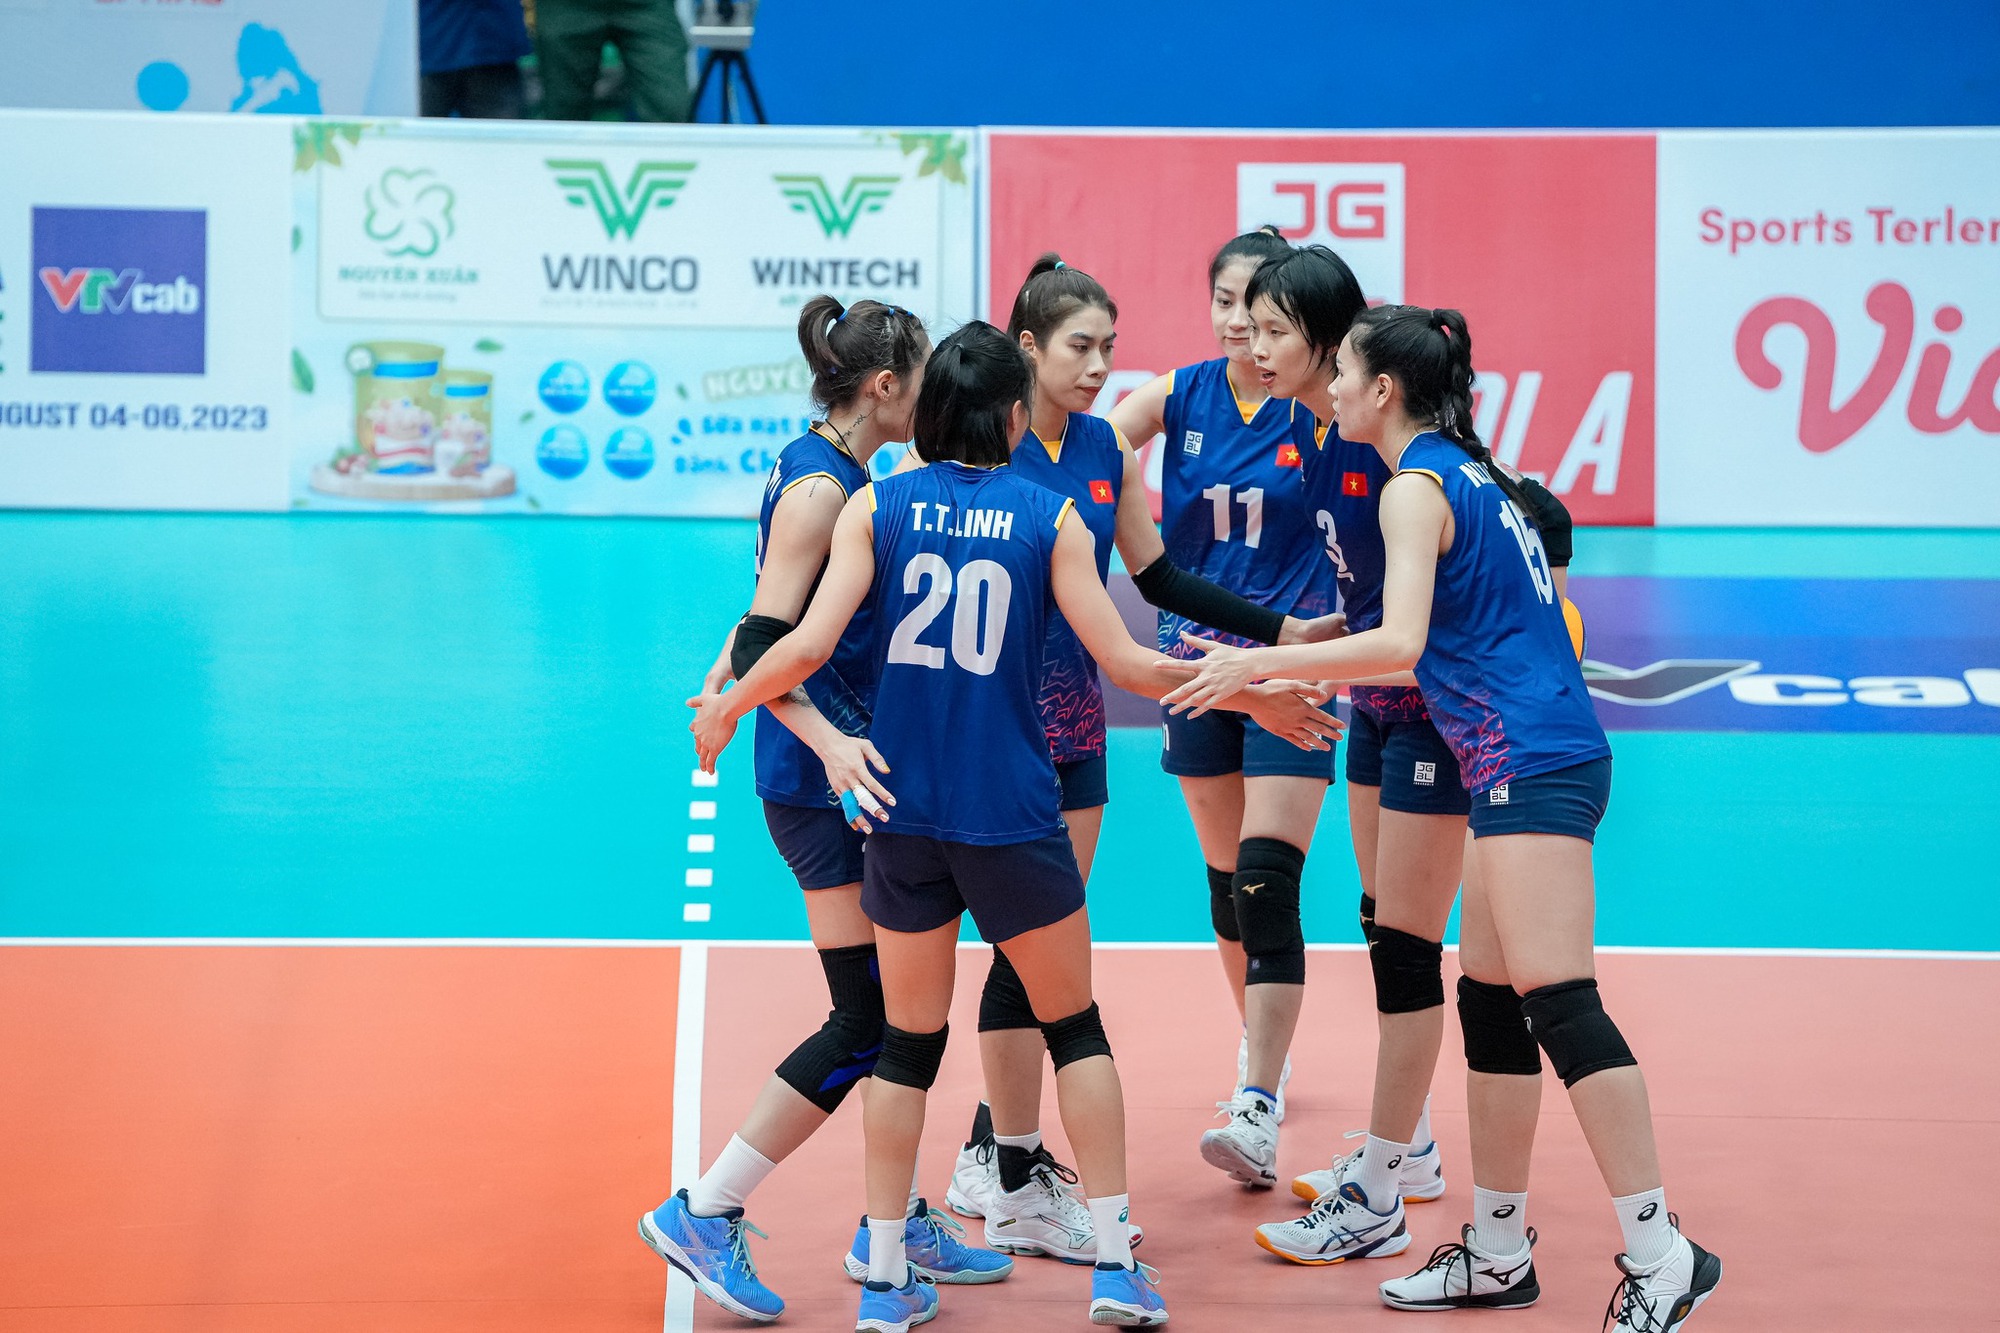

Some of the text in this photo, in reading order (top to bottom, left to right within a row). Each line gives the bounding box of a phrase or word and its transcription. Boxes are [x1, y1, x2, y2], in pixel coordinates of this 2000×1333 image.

[1700, 207, 1852, 255] Sports
[543, 254, 699, 293] WINCO
[751, 258, 920, 288] WINTECH
[0, 403, 80, 429] GUST
[1203, 483, 1264, 549] 11
[1498, 499, 1553, 604] 15
[887, 553, 1012, 676] 20
